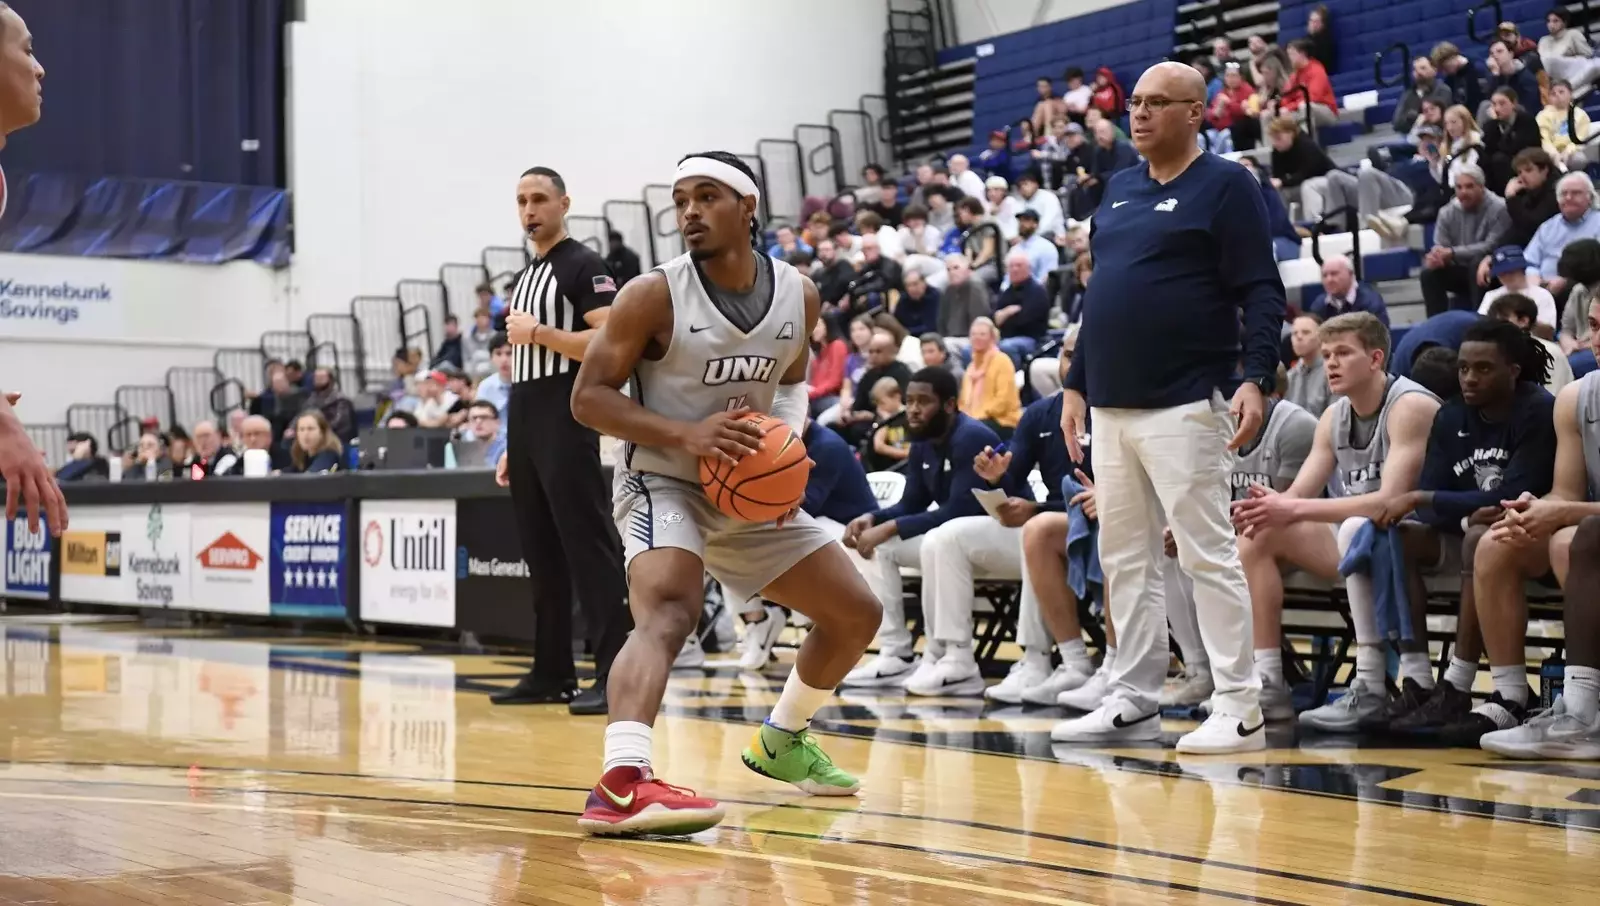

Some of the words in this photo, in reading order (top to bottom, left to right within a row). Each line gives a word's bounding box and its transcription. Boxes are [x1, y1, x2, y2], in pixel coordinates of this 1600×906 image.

[0, 278, 111, 300] Kennebunk
[0, 299, 79, 324] Savings
[703, 355, 777, 387] UNH
[13, 517, 45, 549] BUD
[283, 514, 341, 544] SERVICE
[390, 517, 446, 572] Unitil
[7, 550, 51, 586] LIGHT
[128, 551, 181, 576] Kennebunk
[467, 556, 490, 576] Mass
[490, 557, 524, 578] General
[136, 577, 173, 602] Savings
